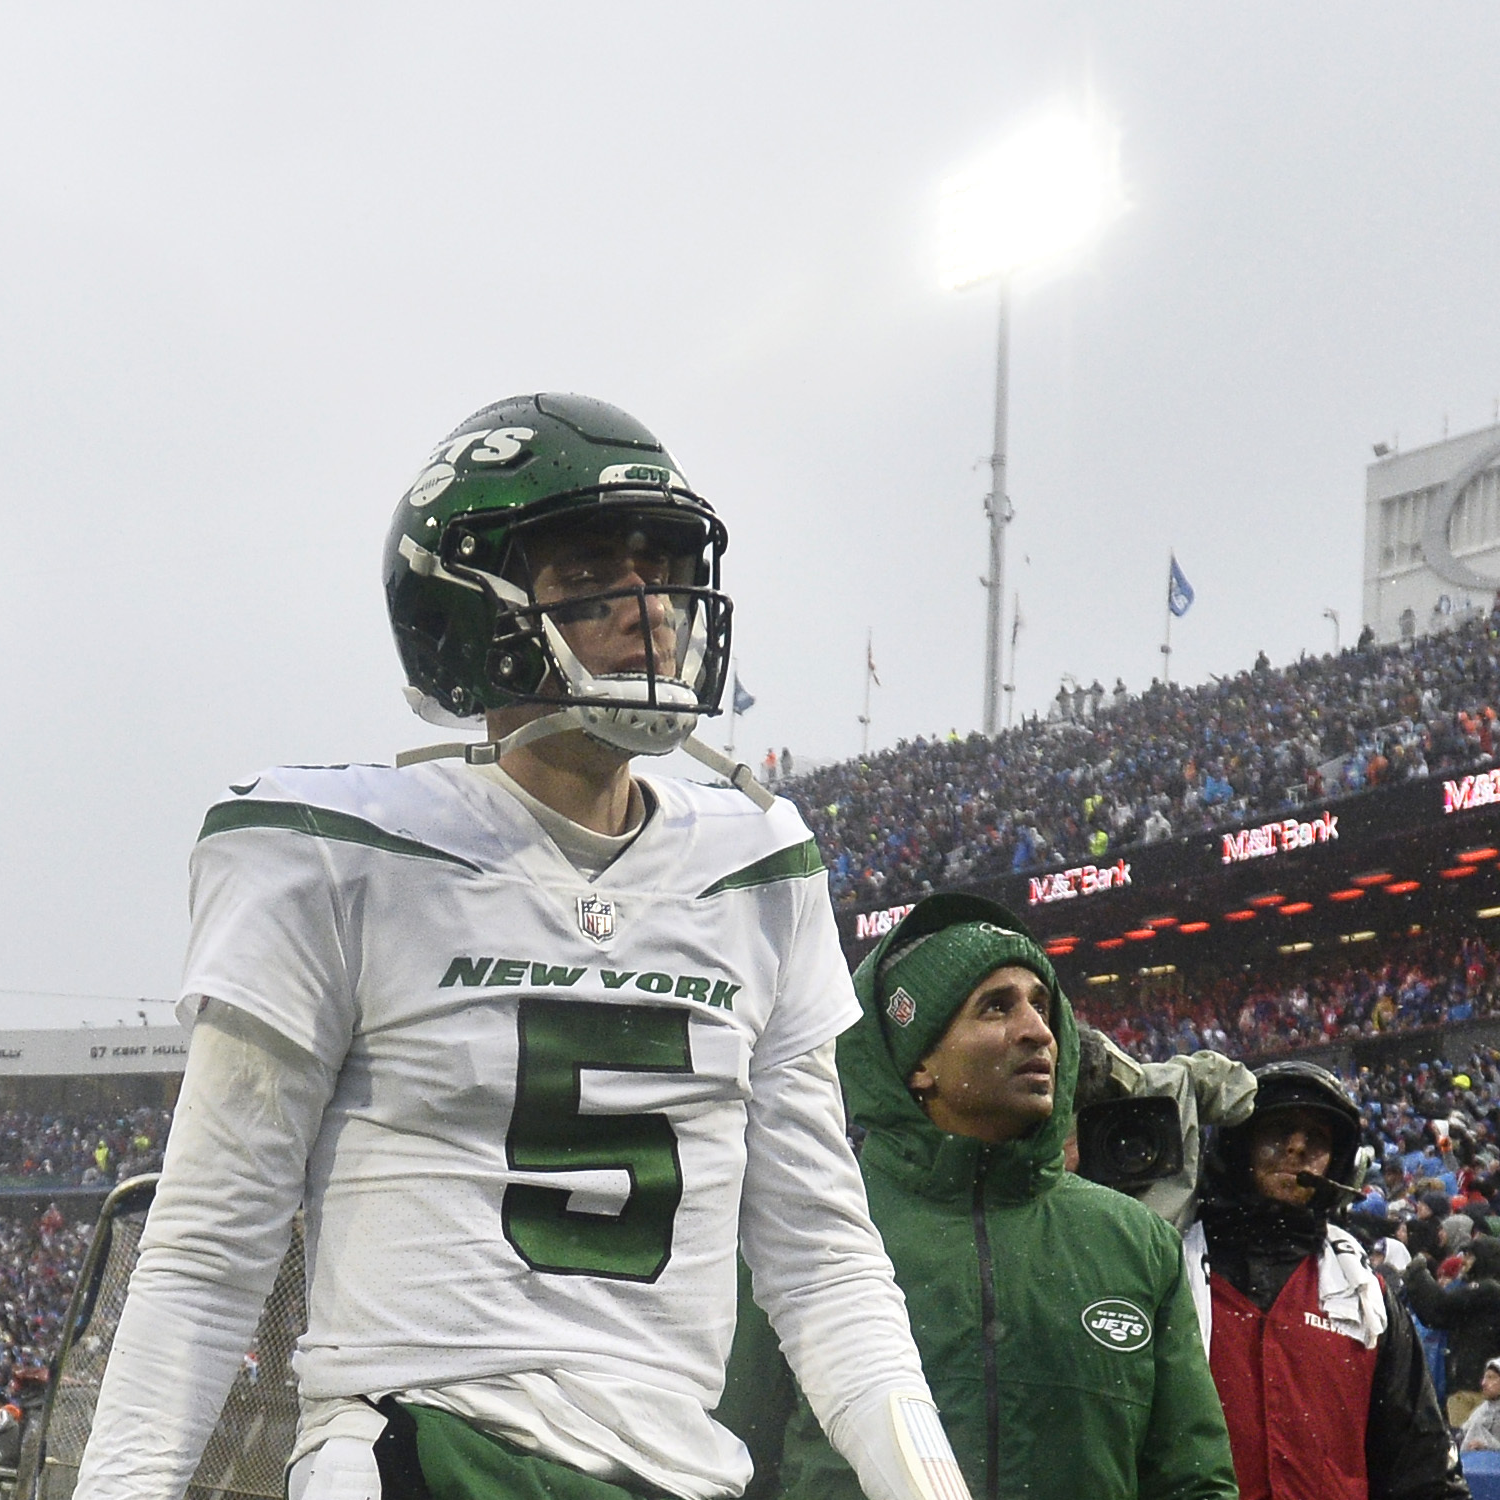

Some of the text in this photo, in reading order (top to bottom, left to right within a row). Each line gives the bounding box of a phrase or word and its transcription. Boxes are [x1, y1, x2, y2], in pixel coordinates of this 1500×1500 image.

[625, 466, 670, 483] JETS
[1222, 822, 1279, 863] M&T
[1029, 867, 1081, 905] M&T
[585, 913, 610, 934] NFL
[439, 957, 742, 1012] NEW YORK
[500, 999, 694, 1285] 5
[1091, 1317, 1144, 1336] JETS
